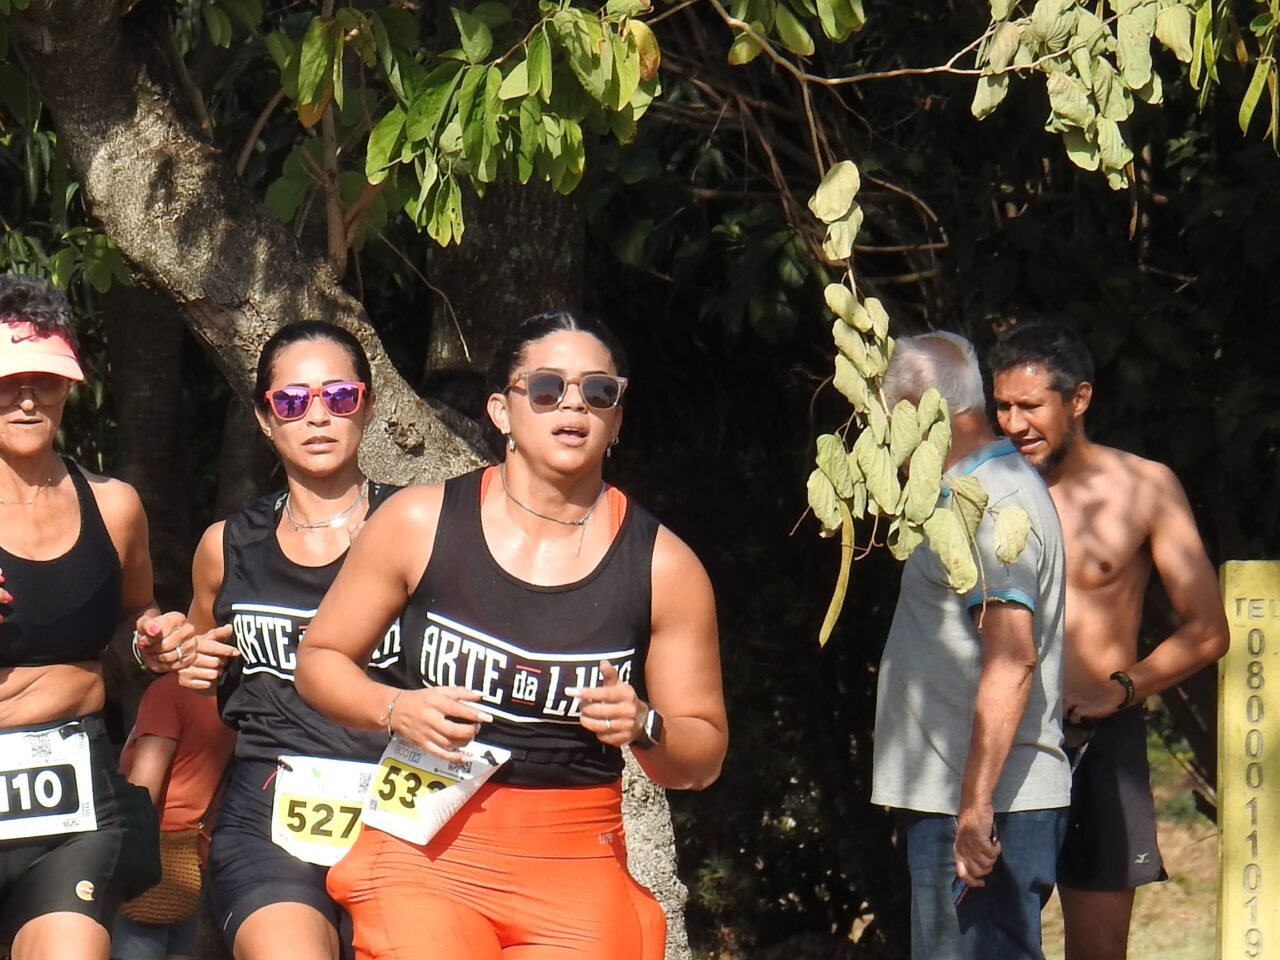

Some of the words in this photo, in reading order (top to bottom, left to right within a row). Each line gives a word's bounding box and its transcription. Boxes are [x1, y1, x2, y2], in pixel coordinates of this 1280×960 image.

[233, 613, 297, 670] ARTE
[421, 625, 508, 705] ARTE
[512, 670, 539, 702] da
[378, 765, 447, 809] 53
